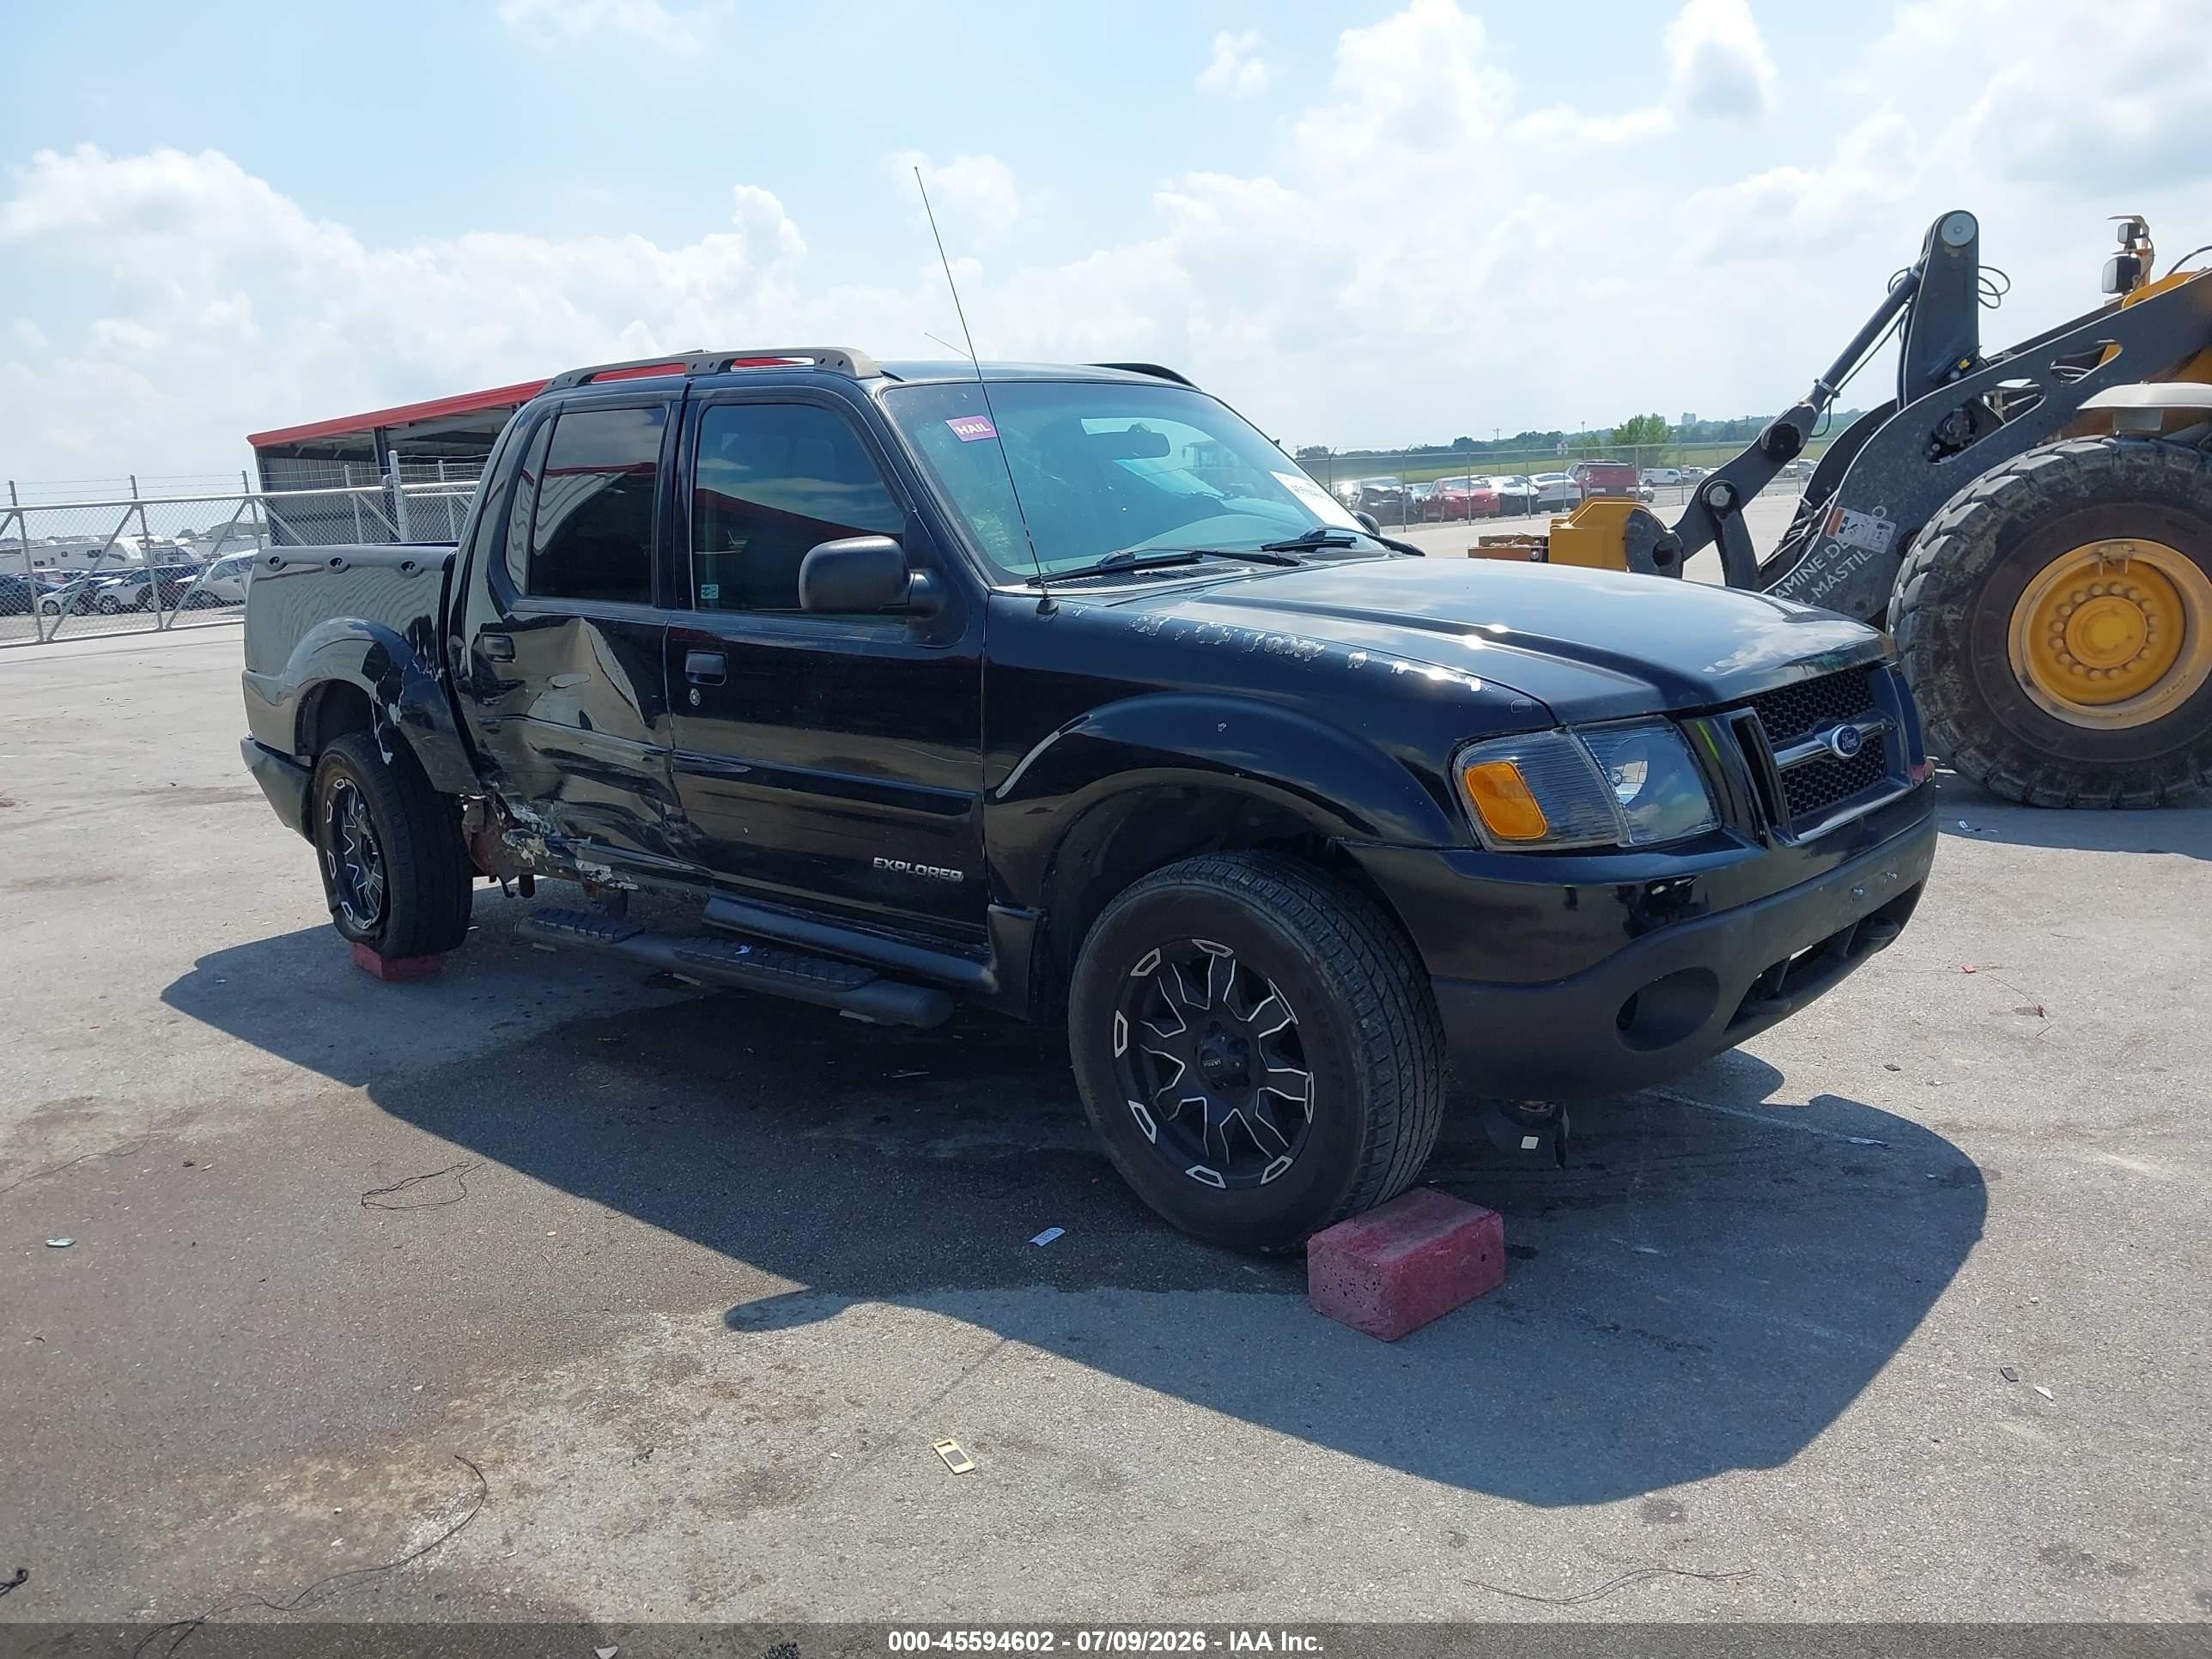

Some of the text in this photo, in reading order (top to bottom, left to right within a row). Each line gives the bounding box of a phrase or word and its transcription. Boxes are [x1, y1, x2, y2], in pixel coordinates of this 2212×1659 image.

[956, 422, 991, 435] HAIL
[1775, 555, 1826, 598] AMINE
[1841, 732, 1858, 750] Ford
[872, 857, 964, 882] EXPLORER
